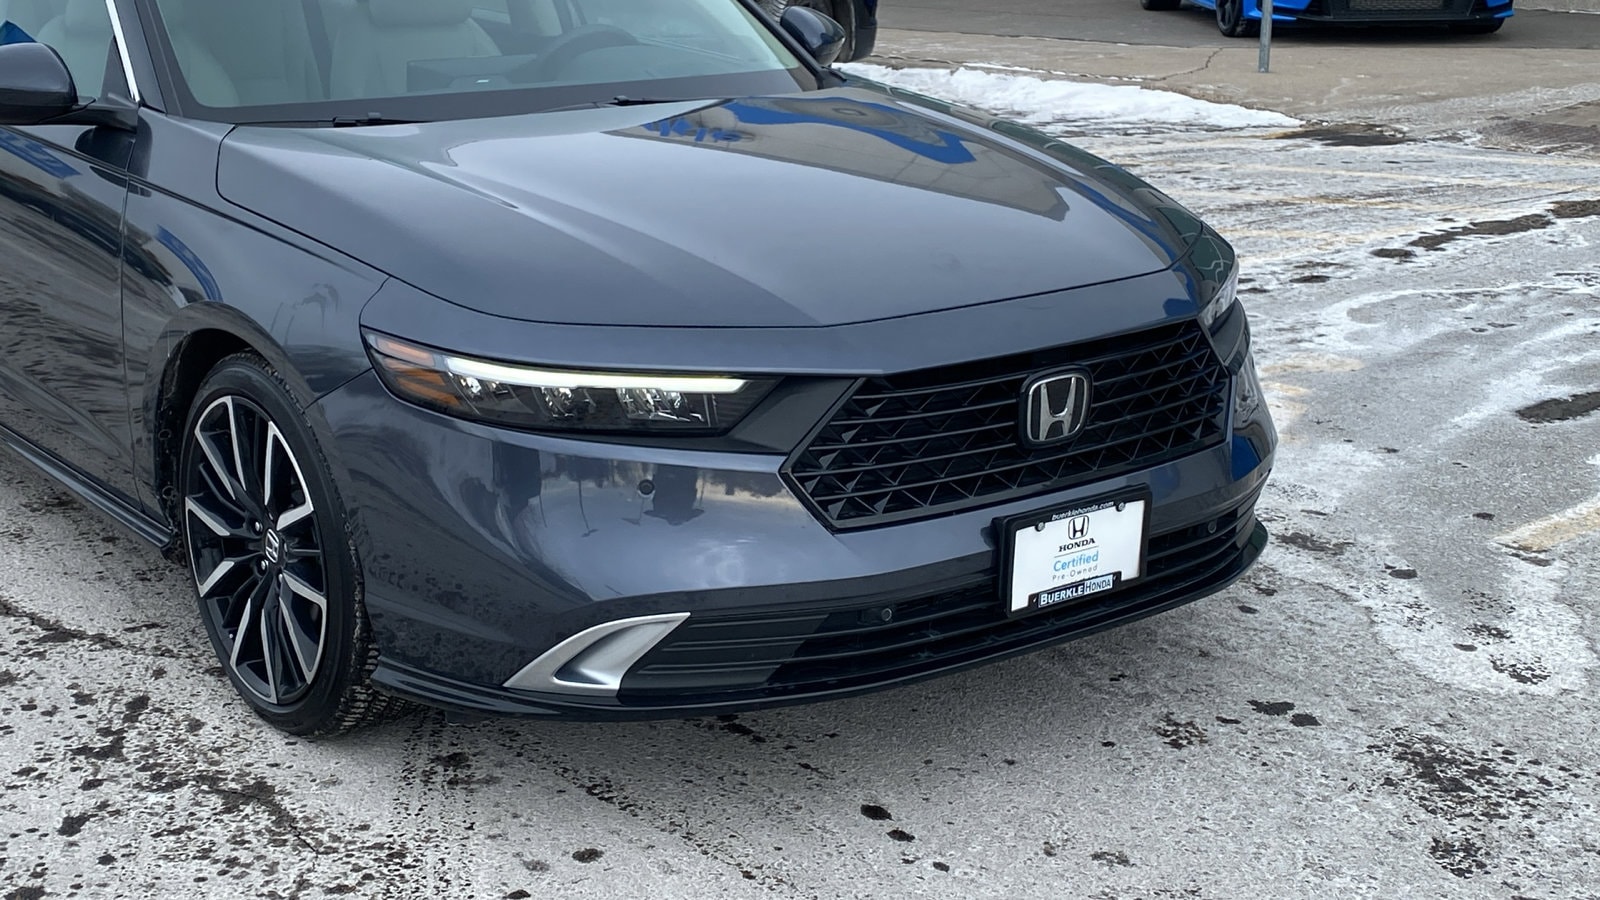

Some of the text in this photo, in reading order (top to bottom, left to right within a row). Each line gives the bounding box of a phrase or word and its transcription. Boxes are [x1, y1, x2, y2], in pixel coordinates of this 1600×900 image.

[1051, 501, 1114, 521] buerklehonda.com
[1058, 537, 1096, 552] HONDA
[1053, 550, 1099, 572] Certified
[1052, 564, 1098, 581] Pre-Owned
[1040, 585, 1084, 606] BUERKLE
[1085, 579, 1112, 593] HONDA
